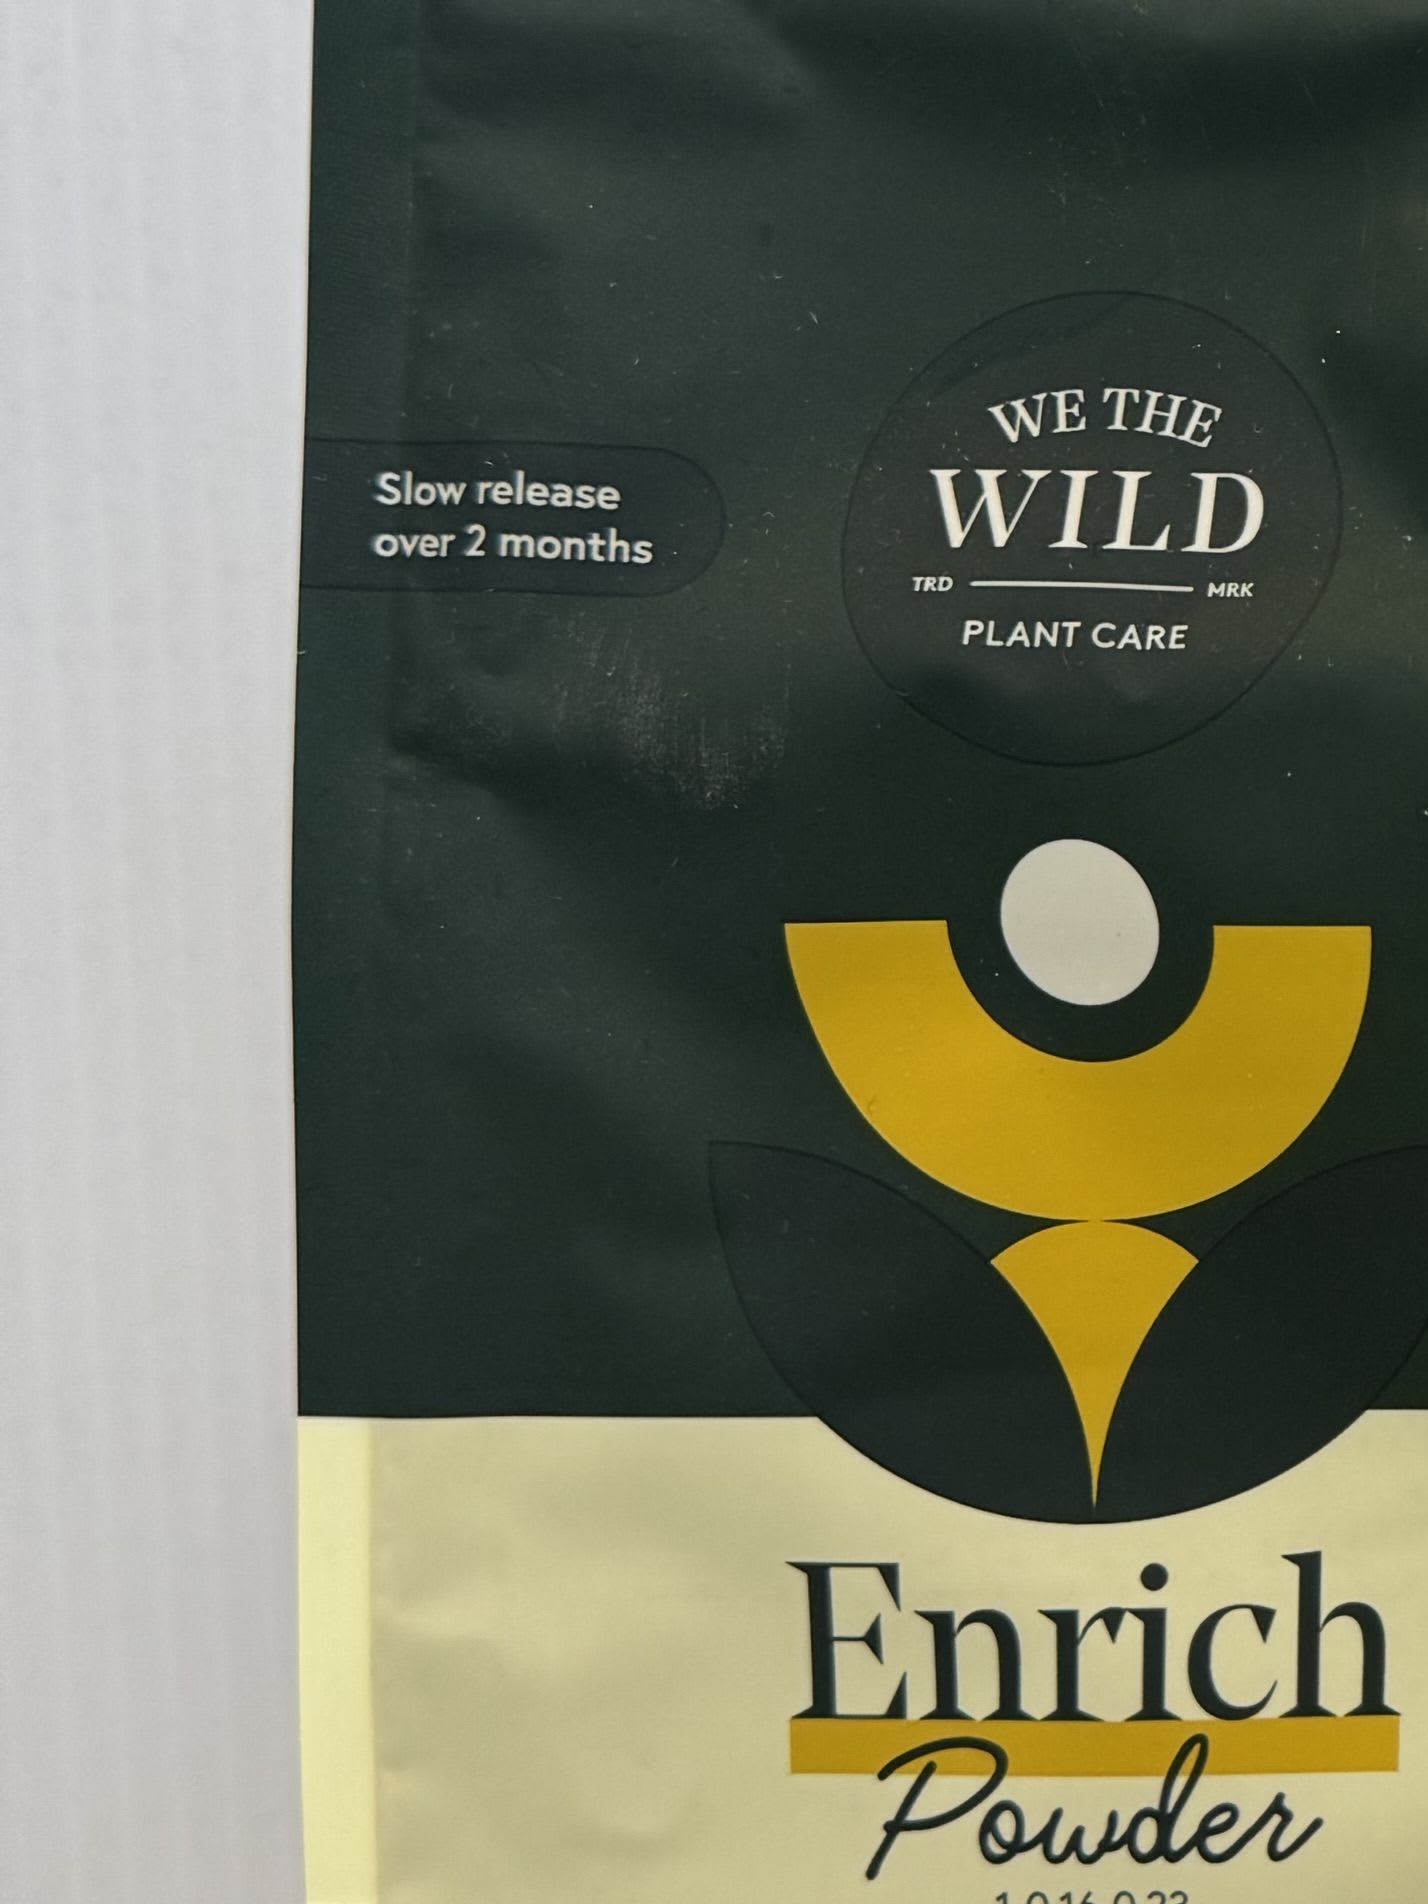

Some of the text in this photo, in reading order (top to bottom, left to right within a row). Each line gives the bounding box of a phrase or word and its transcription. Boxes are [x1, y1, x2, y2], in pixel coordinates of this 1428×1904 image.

[988, 388, 1222, 447] WE THE
[375, 470, 621, 510] Slow release
[929, 469, 1264, 553] WILD
[373, 523, 653, 564] over 2 months
[912, 576, 1254, 597] TRD MRK
[962, 620, 1188, 650] PLANT CARE
[786, 1550, 1402, 1721] Enrich
[866, 1733, 1323, 1881] Powder
